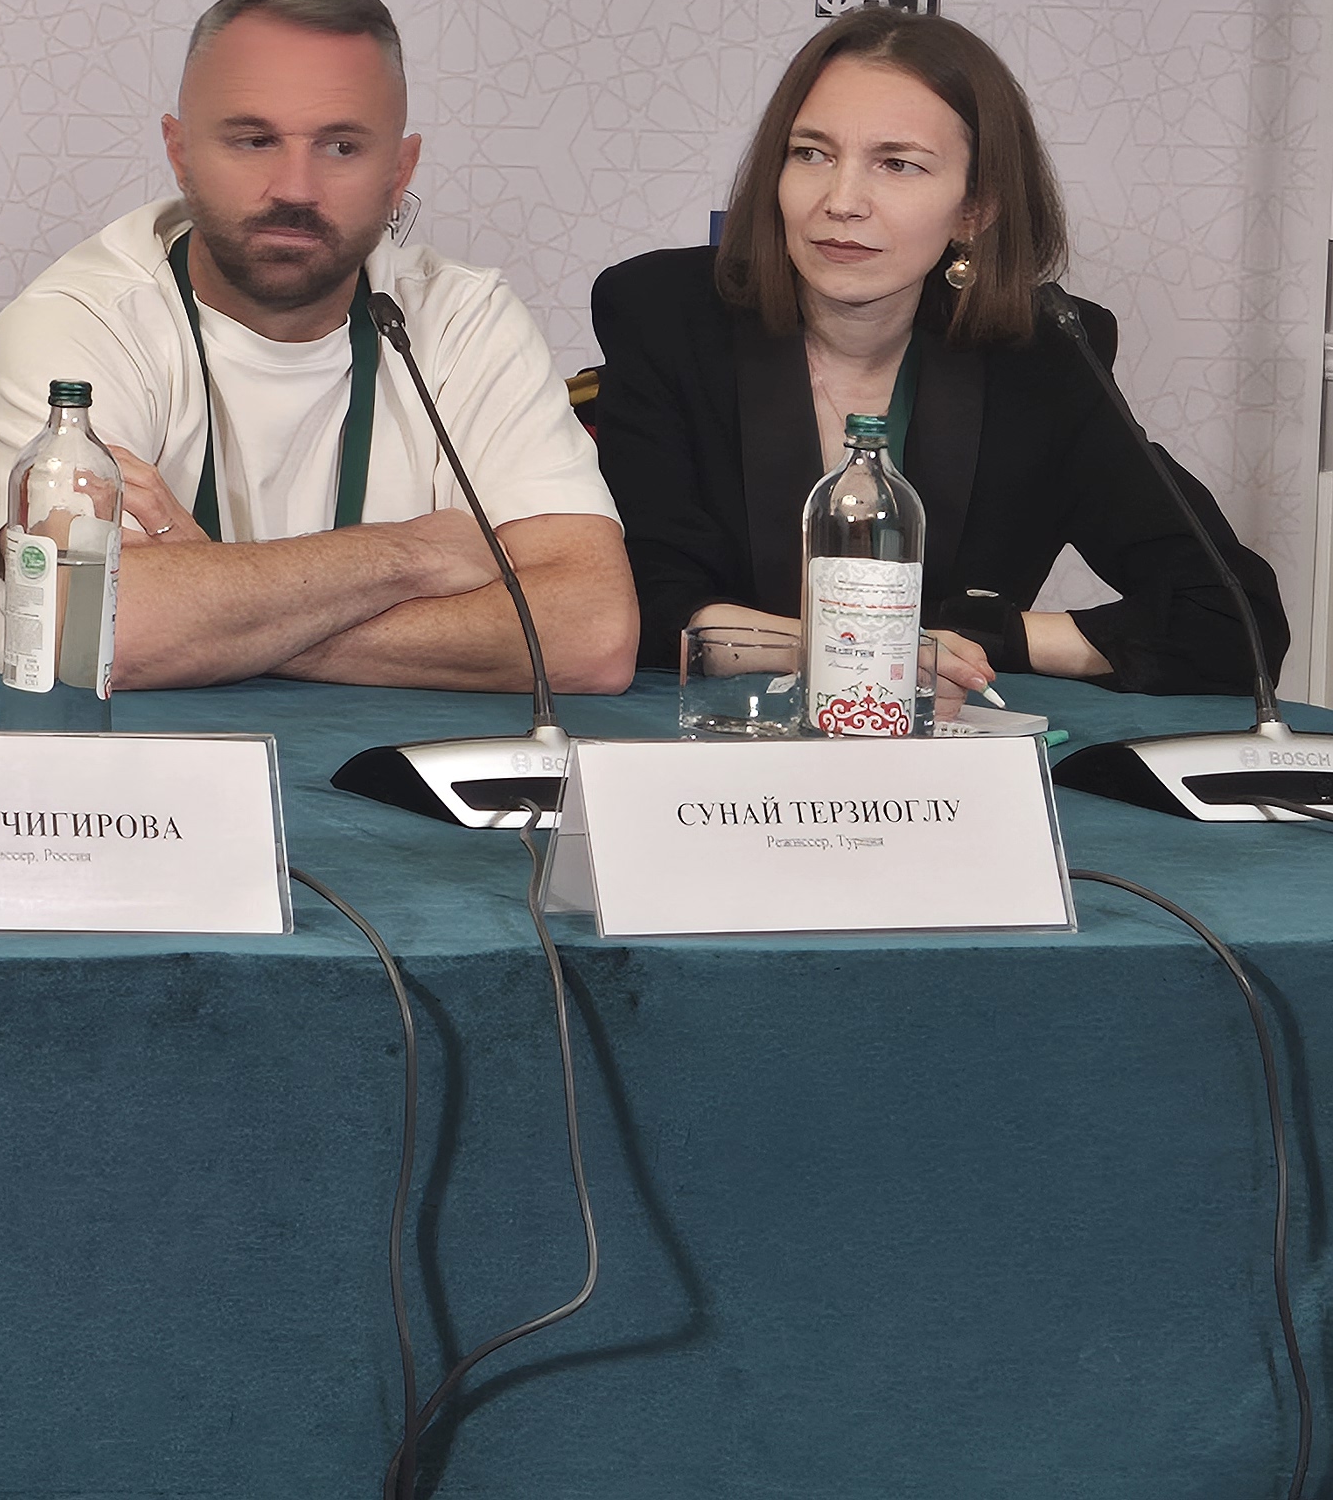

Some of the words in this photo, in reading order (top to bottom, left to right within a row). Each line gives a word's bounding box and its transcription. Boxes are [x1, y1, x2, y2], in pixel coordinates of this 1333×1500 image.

[1269, 751, 1331, 767] BOSCH
[0, 811, 184, 840] ЧИГИРОВА
[677, 796, 782, 826] СУНАЙ
[789, 799, 961, 824] ТЕРЗИОГЛУ
